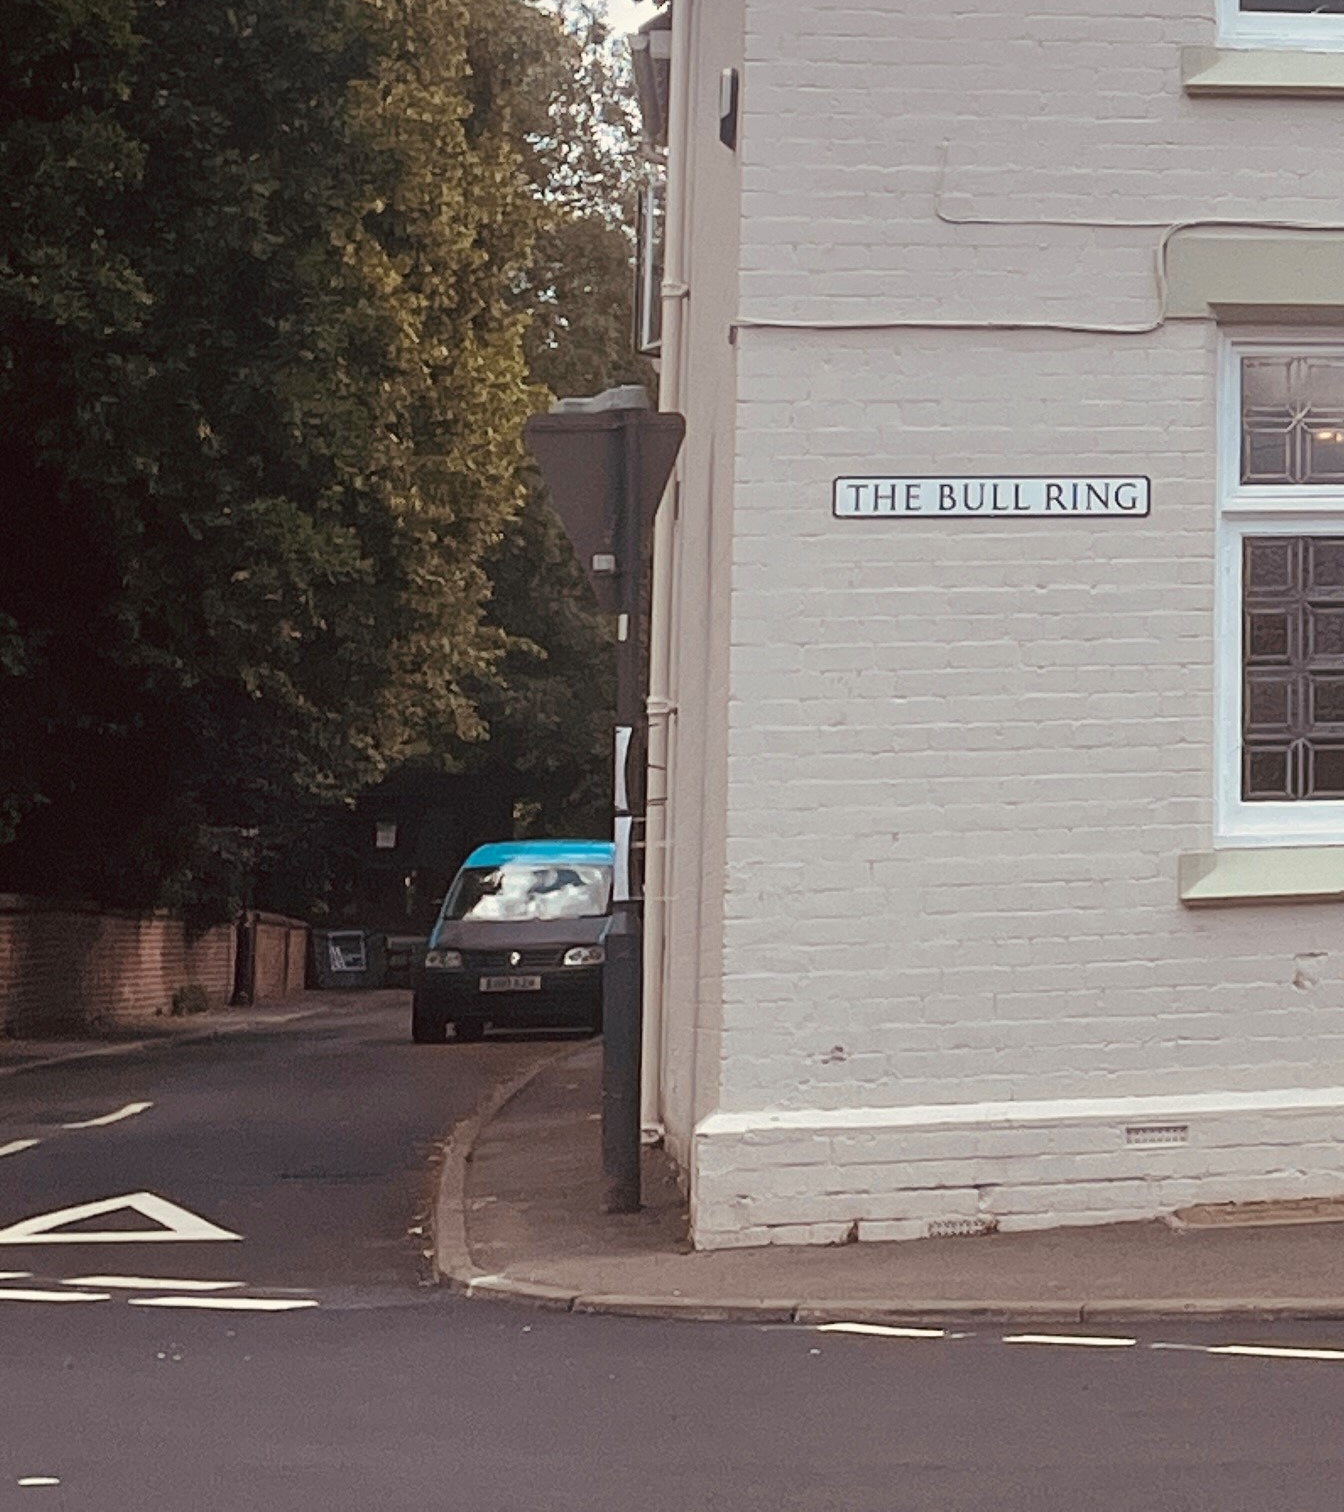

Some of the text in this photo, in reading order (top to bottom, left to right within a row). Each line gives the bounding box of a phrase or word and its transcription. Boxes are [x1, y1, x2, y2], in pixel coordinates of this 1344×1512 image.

[846, 482, 1138, 512] THE BULL RING
